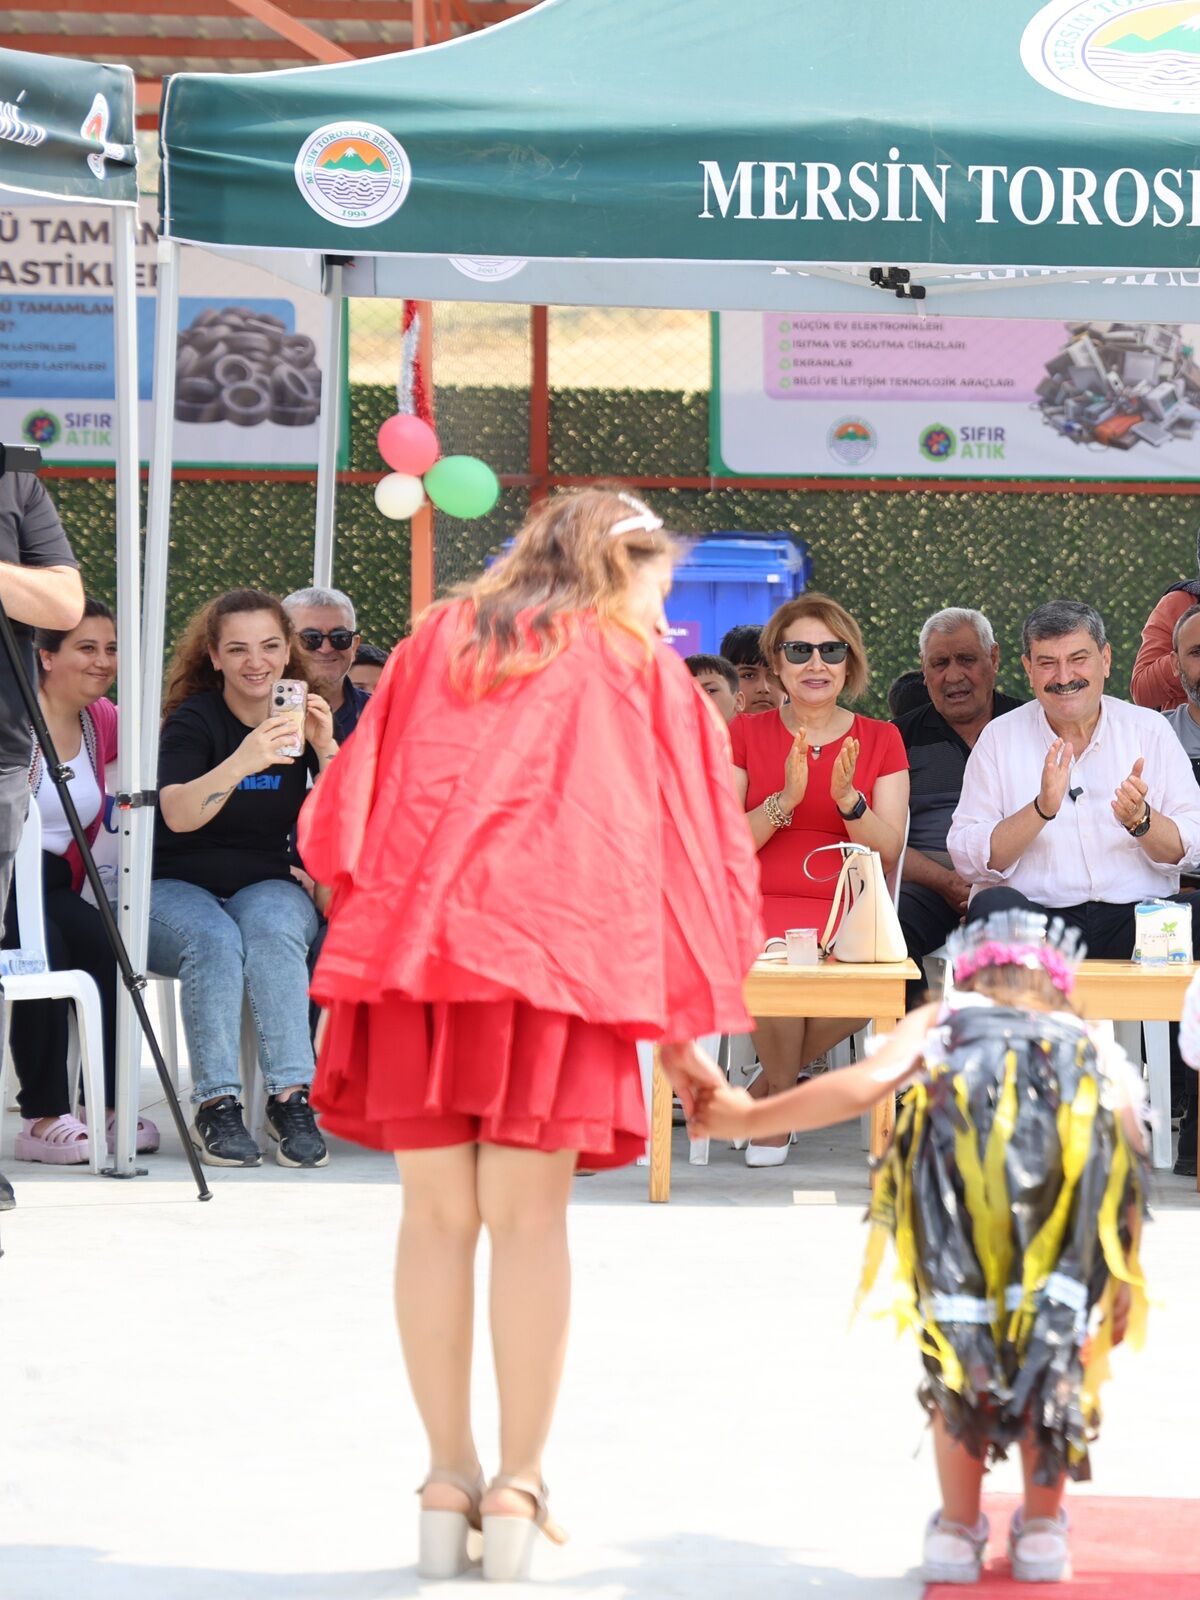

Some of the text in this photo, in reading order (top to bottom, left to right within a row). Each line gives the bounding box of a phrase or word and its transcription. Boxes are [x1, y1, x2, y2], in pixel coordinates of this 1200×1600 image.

[316, 129, 370, 148] TOROSLAR
[698, 147, 951, 223] MERSİN
[834, 321, 848, 330] EV
[824, 376, 838, 385] VE
[64, 412, 112, 428] SIFIR
[66, 430, 112, 446] ATIK
[960, 426, 1006, 442] SIFIR
[960, 443, 1006, 460] ATIK
